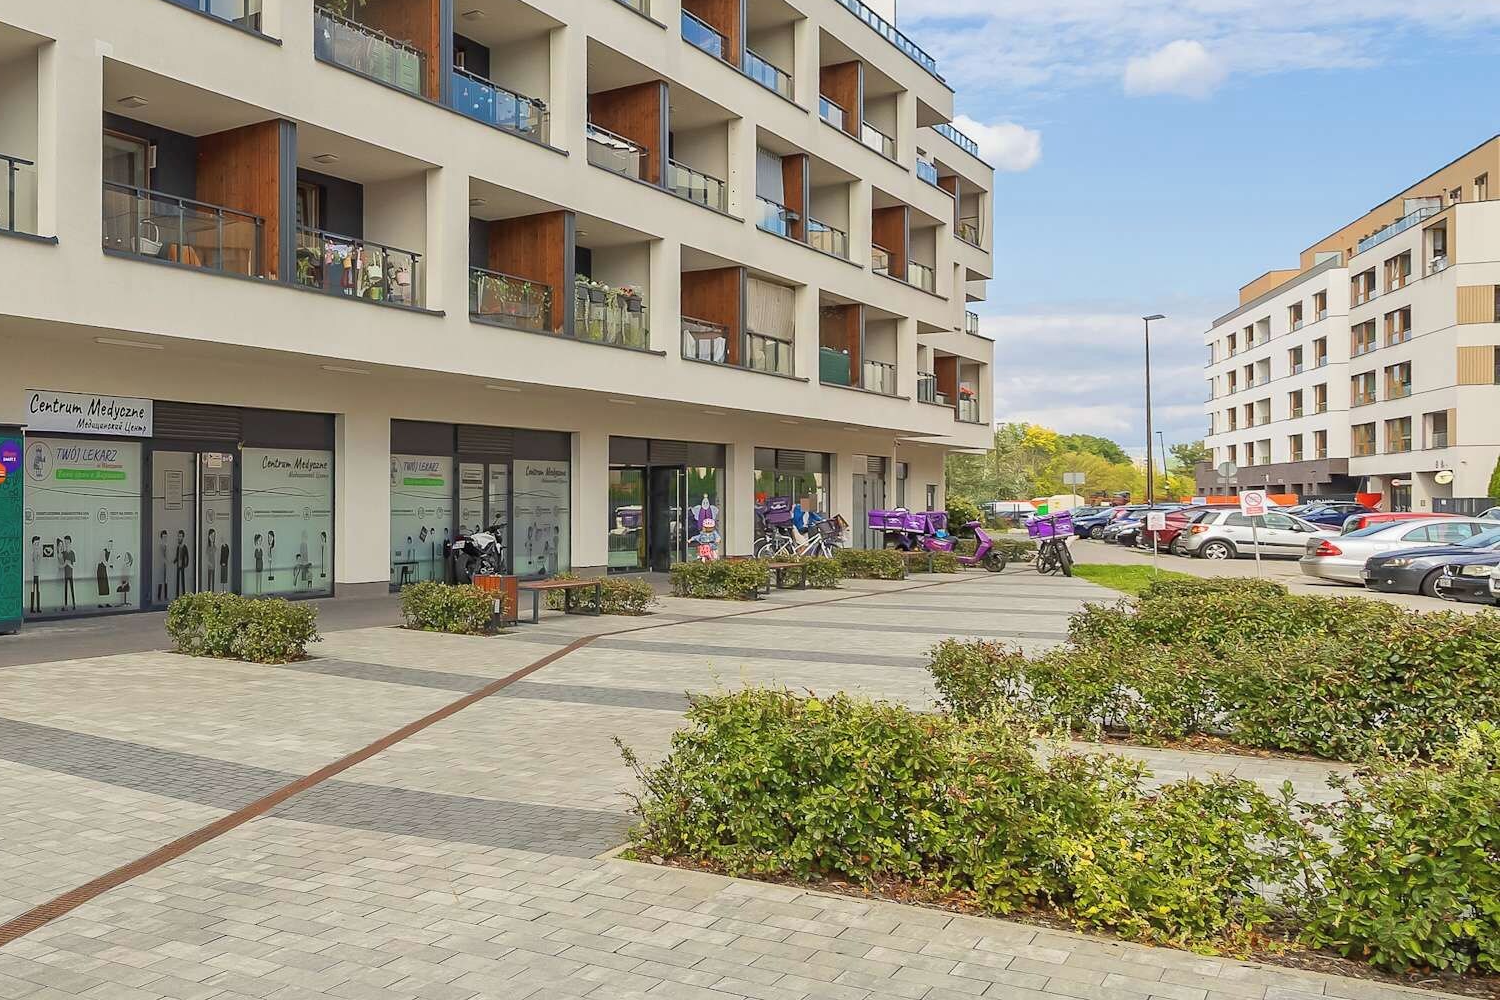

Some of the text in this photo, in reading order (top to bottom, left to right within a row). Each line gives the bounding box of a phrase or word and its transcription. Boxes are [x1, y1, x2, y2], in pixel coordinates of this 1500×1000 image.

[30, 394, 145, 420] Centrum Medyczne
[56, 446, 118, 463] TWÓJ LEKARZ
[262, 455, 328, 471] Centrum Medyczne
